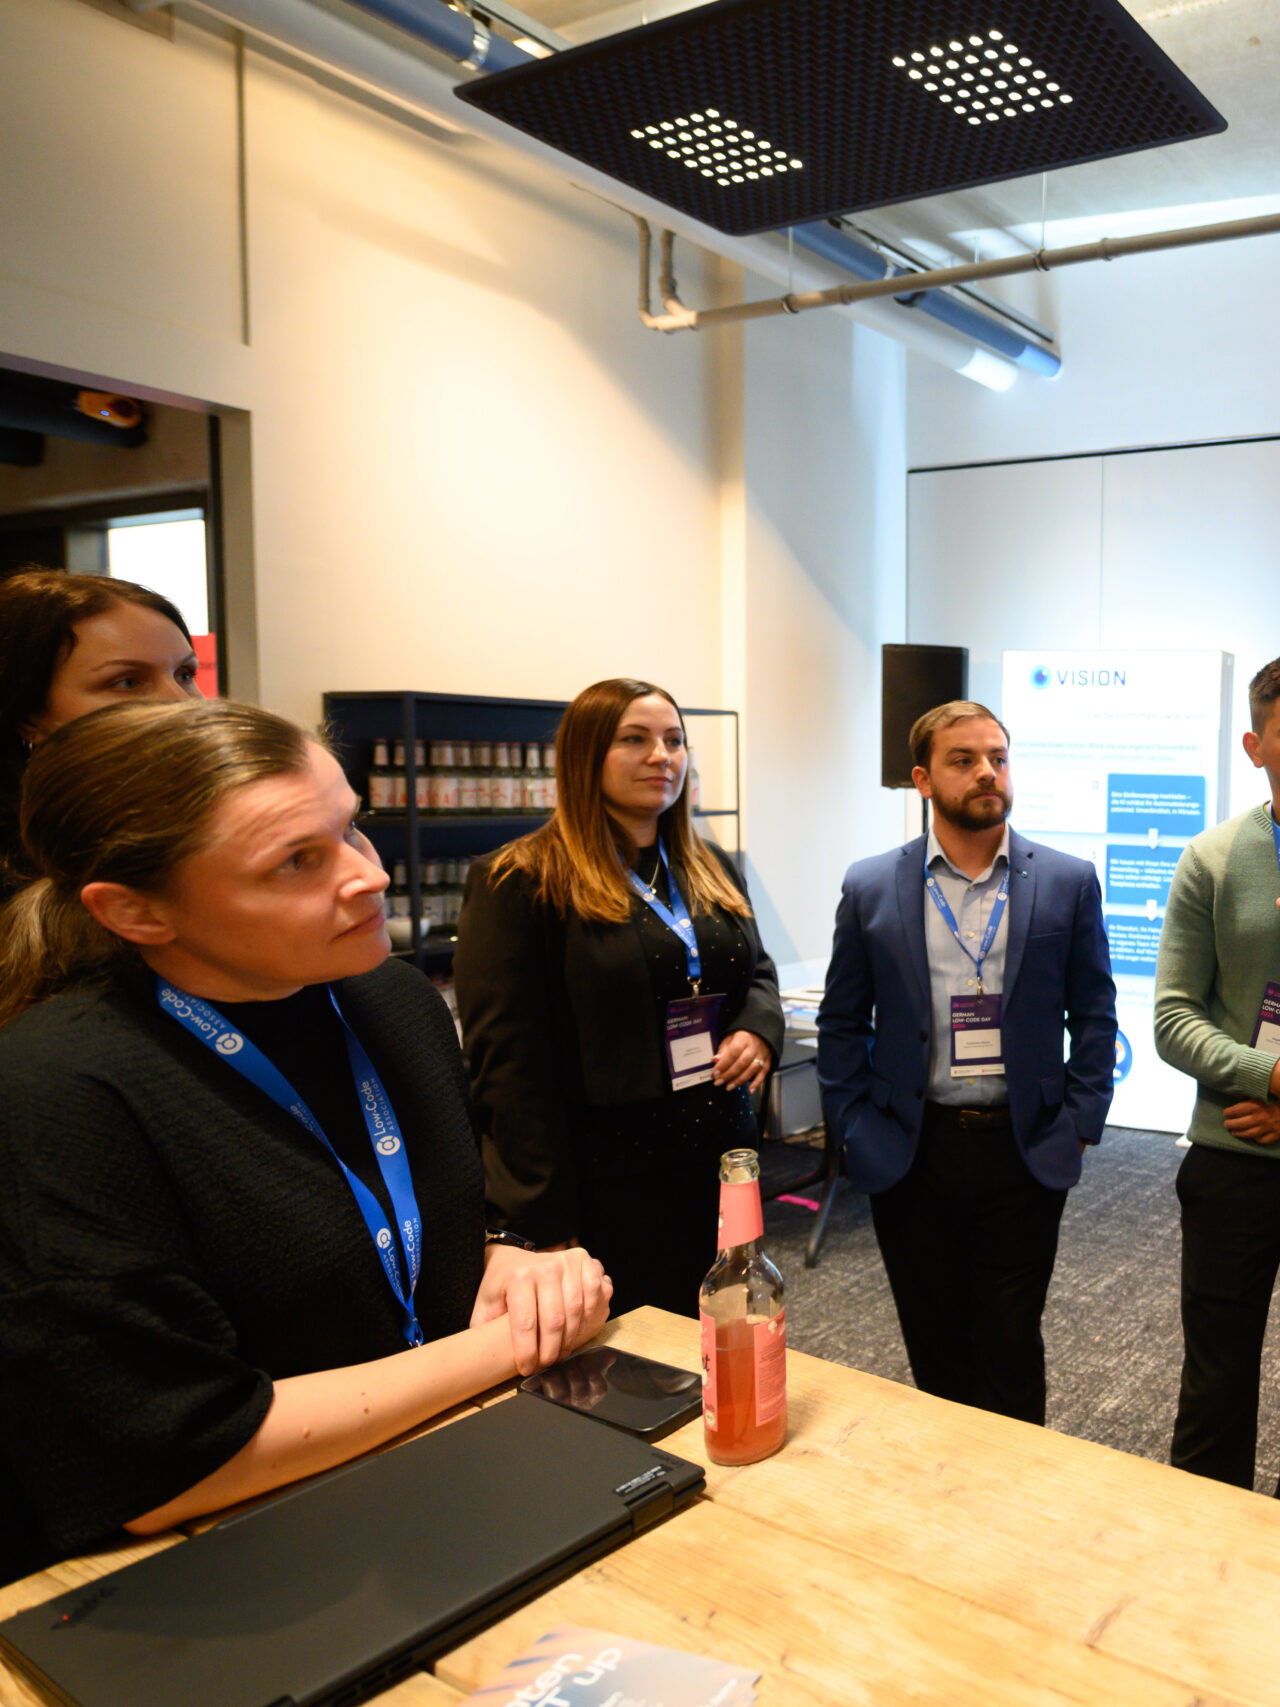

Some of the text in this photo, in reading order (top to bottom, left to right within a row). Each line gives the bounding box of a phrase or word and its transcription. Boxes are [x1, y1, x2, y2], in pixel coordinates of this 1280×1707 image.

[1056, 670, 1127, 686] VISION
[161, 987, 219, 1041] Low-Code
[361, 1080, 388, 1137] Low-Code
[369, 1077, 395, 1131] ASSOCIATION
[403, 1219, 418, 1280] Low-Code
[572, 1647, 623, 1686] up
